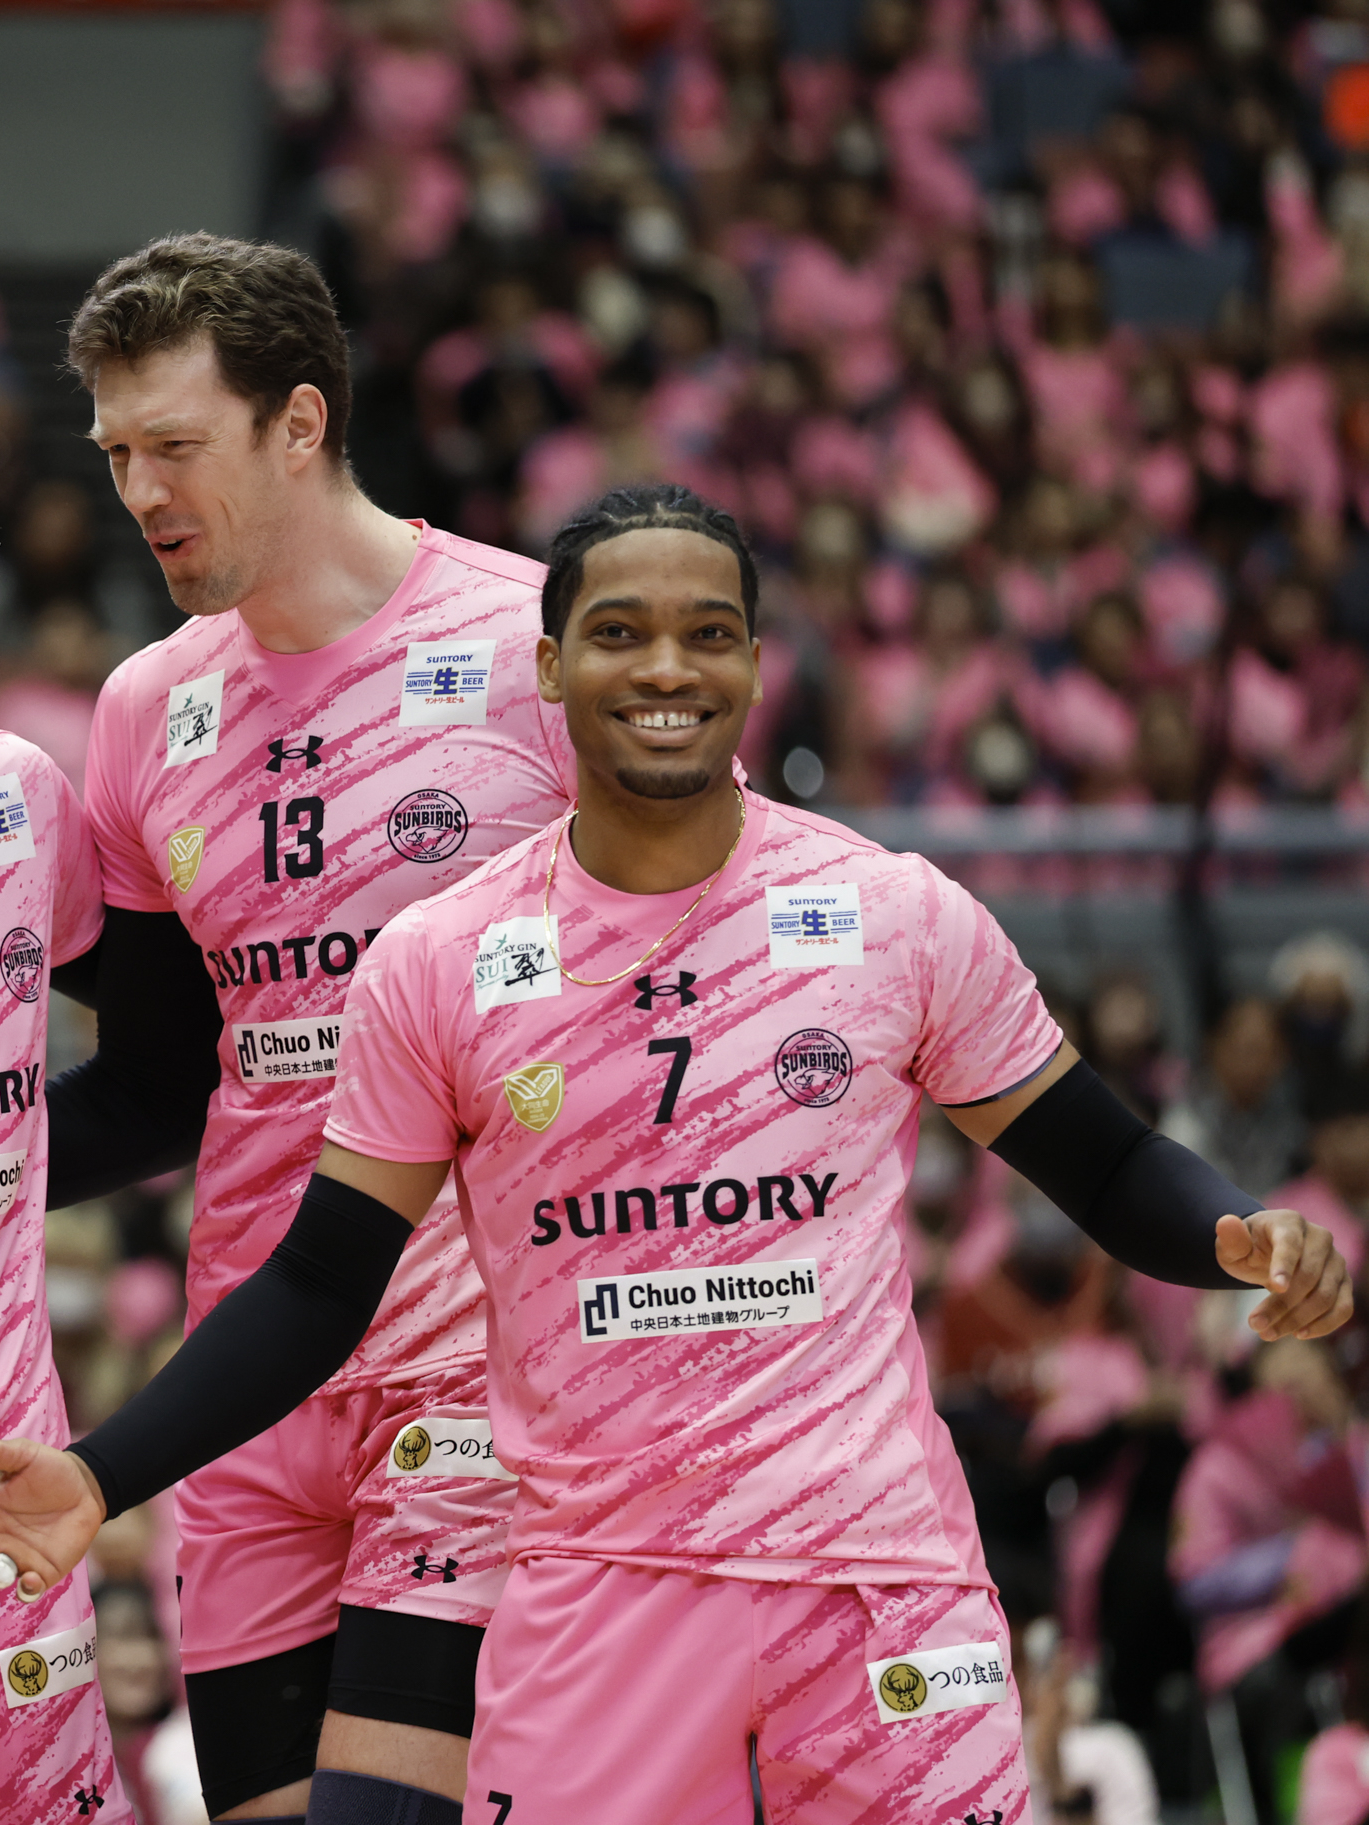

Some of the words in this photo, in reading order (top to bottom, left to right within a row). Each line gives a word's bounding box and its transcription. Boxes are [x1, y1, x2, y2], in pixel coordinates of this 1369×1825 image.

[426, 654, 473, 664] SUNTORY
[405, 678, 433, 688] SUNTORY
[433, 666, 460, 696] 生
[462, 677, 484, 686] BEER
[169, 705, 197, 723] SUNTORY
[197, 701, 210, 713] GIN
[169, 719, 191, 742] SUI
[8, 811, 25, 822] BEER
[394, 810, 462, 837] SUNBIRDS
[258, 796, 325, 883] 13
[788, 898, 838, 906] SUNTORY
[771, 920, 800, 930] SUNTORY
[801, 909, 829, 937] 生
[832, 918, 856, 926] BEER
[3, 946, 43, 979] SUNBIRDS
[207, 928, 382, 989] SUNTO
[474, 944, 516, 963] SUNTORY
[517, 942, 537, 952] GIN
[475, 957, 509, 983] SUI
[260, 1032, 311, 1056] Chuo
[317, 1025, 340, 1050] Ni
[782, 1052, 847, 1079] SUNBIRDS
[647, 1036, 692, 1125] 7
[531, 1172, 839, 1246] SUNTORY
[628, 1283, 696, 1310] Chuo
[706, 1269, 815, 1302] Nittochi
[630, 1305, 790, 1332] 中央日本土地建物グループ
[927, 1660, 1004, 1690] つの食品
[487, 1790, 512, 1825] 7
